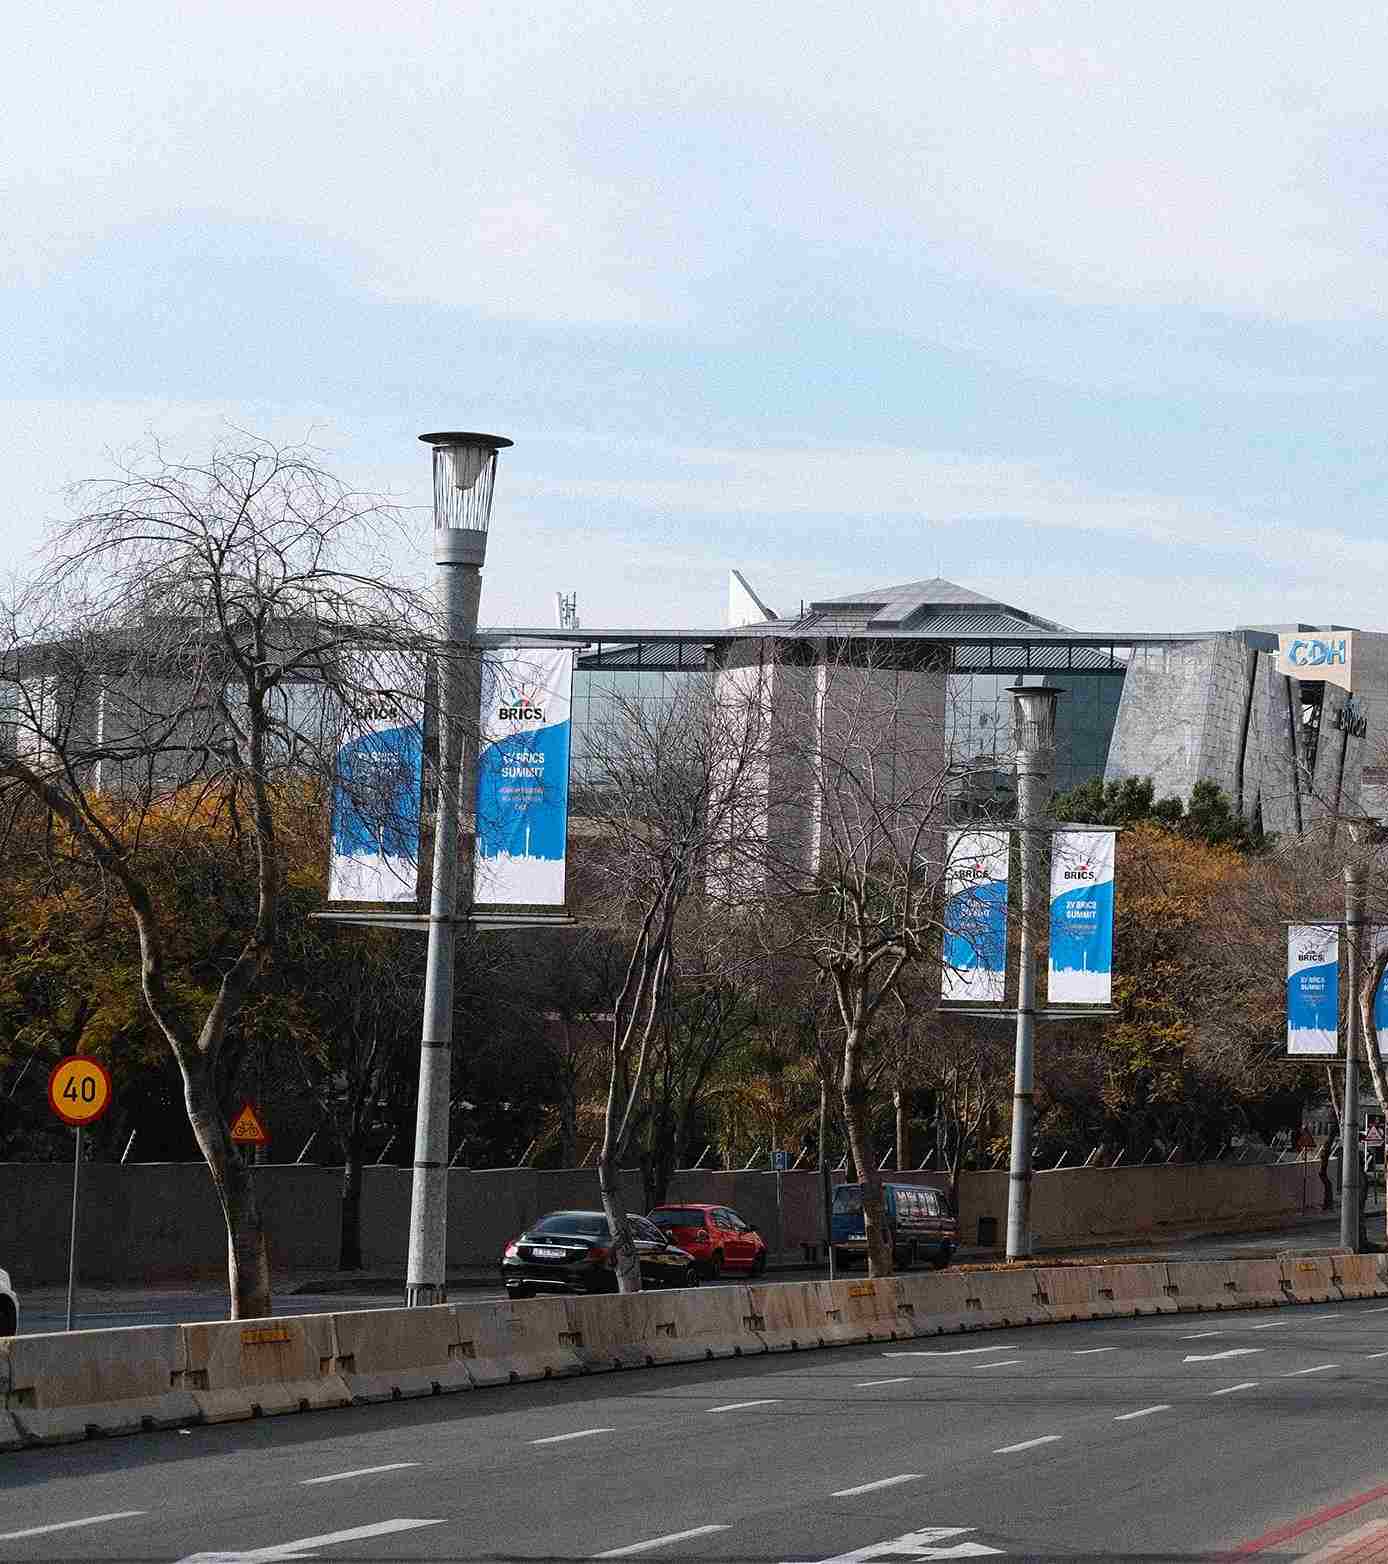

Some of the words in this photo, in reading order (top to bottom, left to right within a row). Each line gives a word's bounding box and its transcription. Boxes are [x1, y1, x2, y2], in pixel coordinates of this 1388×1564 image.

[1288, 639, 1346, 666] CDH
[499, 707, 543, 721] BRICS
[1064, 871, 1095, 881] BRICS
[1066, 911, 1097, 920] SUMMIT
[1298, 954, 1323, 962] BRICS
[63, 1076, 96, 1103] 40
